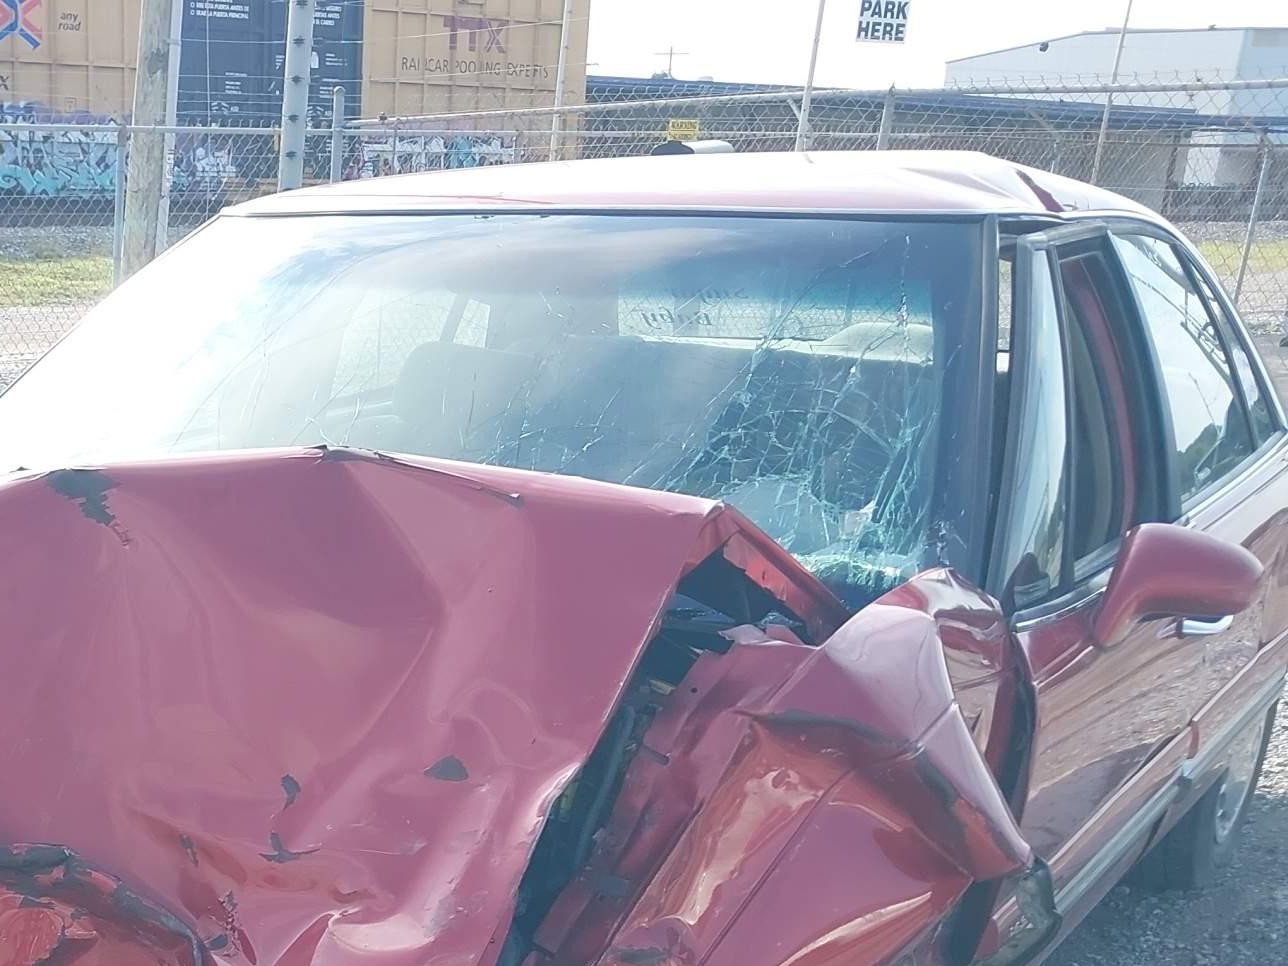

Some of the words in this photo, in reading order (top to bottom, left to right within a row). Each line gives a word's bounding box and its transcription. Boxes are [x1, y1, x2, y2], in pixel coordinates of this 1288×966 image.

[860, 0, 909, 19] PARK
[60, 13, 78, 22] any
[58, 22, 81, 31] road
[857, 21, 906, 41] HERE
